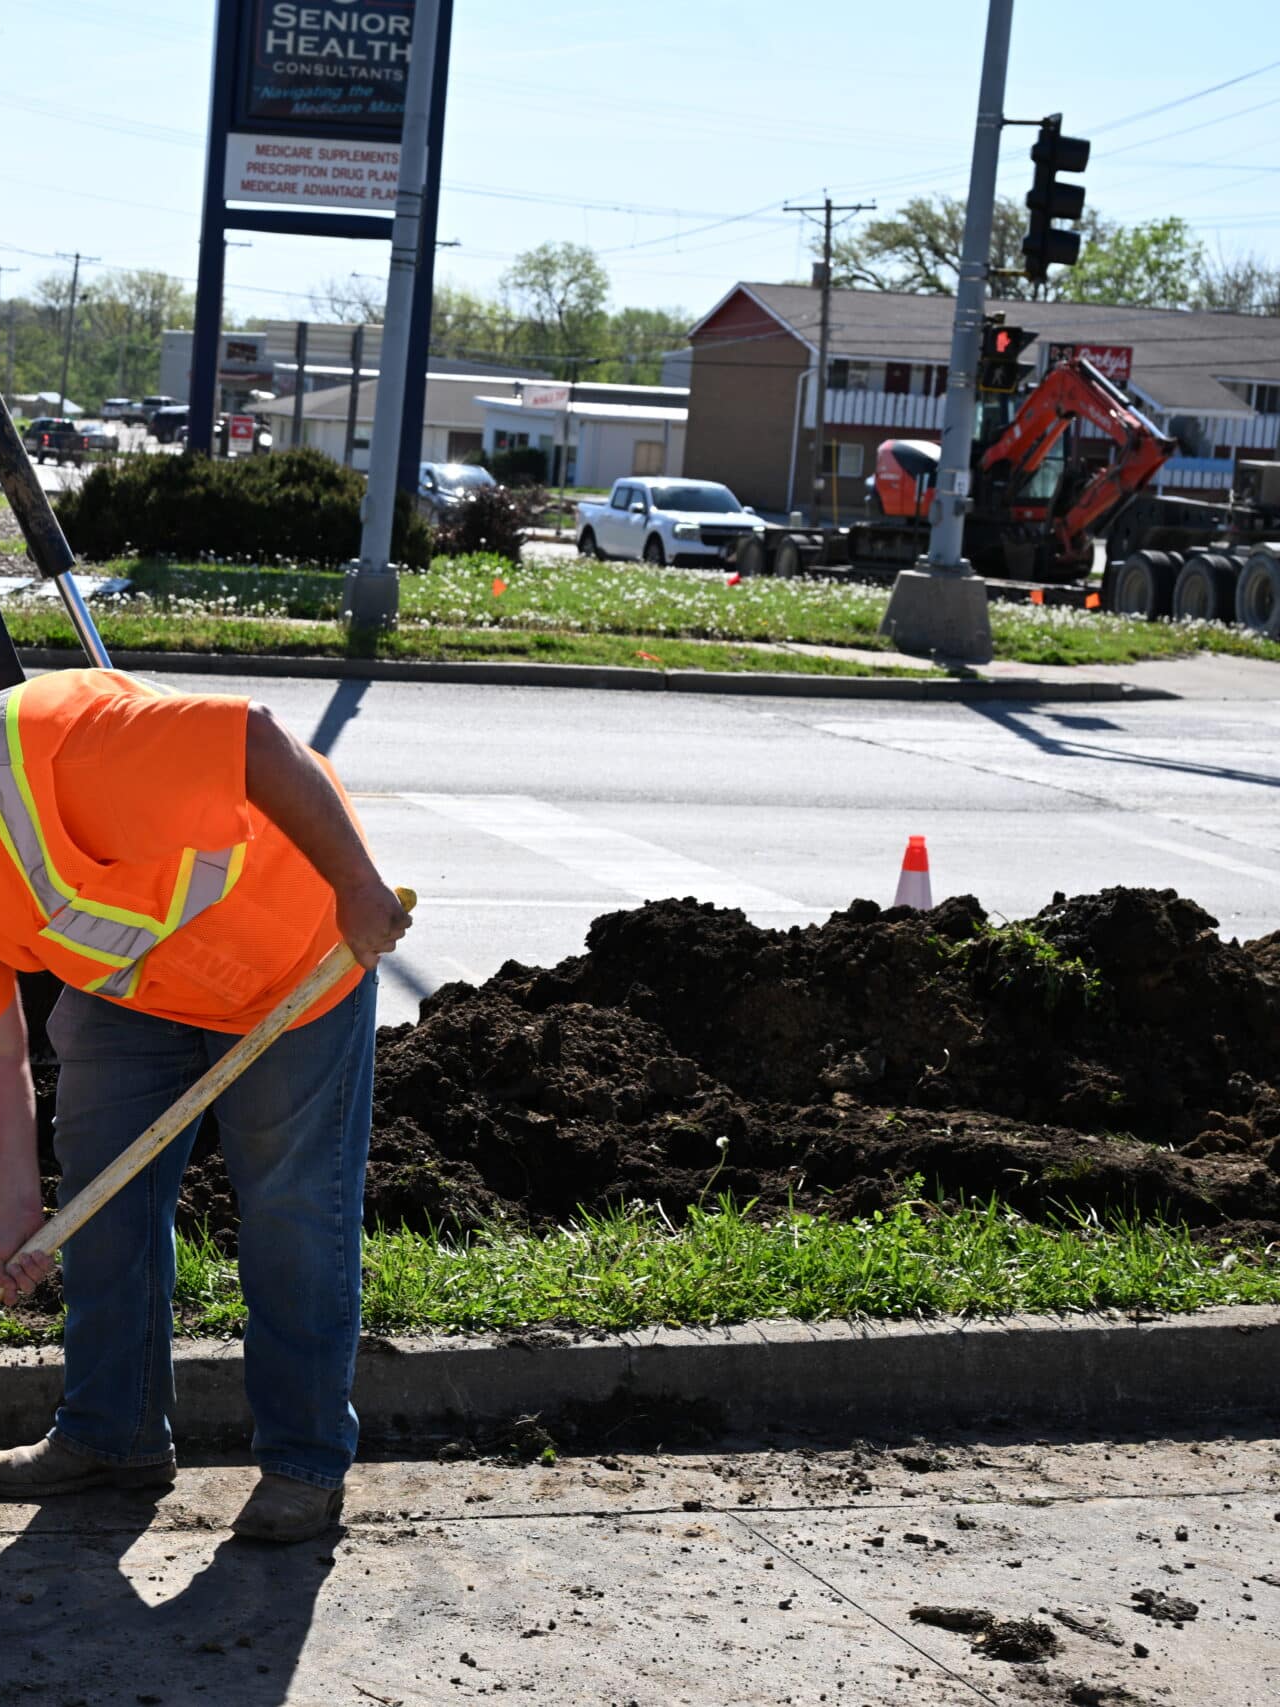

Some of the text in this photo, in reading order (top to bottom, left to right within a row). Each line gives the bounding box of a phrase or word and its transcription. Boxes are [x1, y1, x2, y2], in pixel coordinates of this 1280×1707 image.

[272, 3, 411, 36] SENIOR
[266, 30, 413, 63] HEALTH
[273, 61, 404, 81] CONSULTANTS
[291, 102, 363, 114] Medicare
[255, 144, 400, 165] MEDICARE SUPPLEMENTS
[246, 161, 328, 178] PRESCRIPTION
[332, 167, 364, 180] DRUG
[240, 179, 297, 195] MEDICARE
[303, 184, 367, 199] ADVANTAGE
